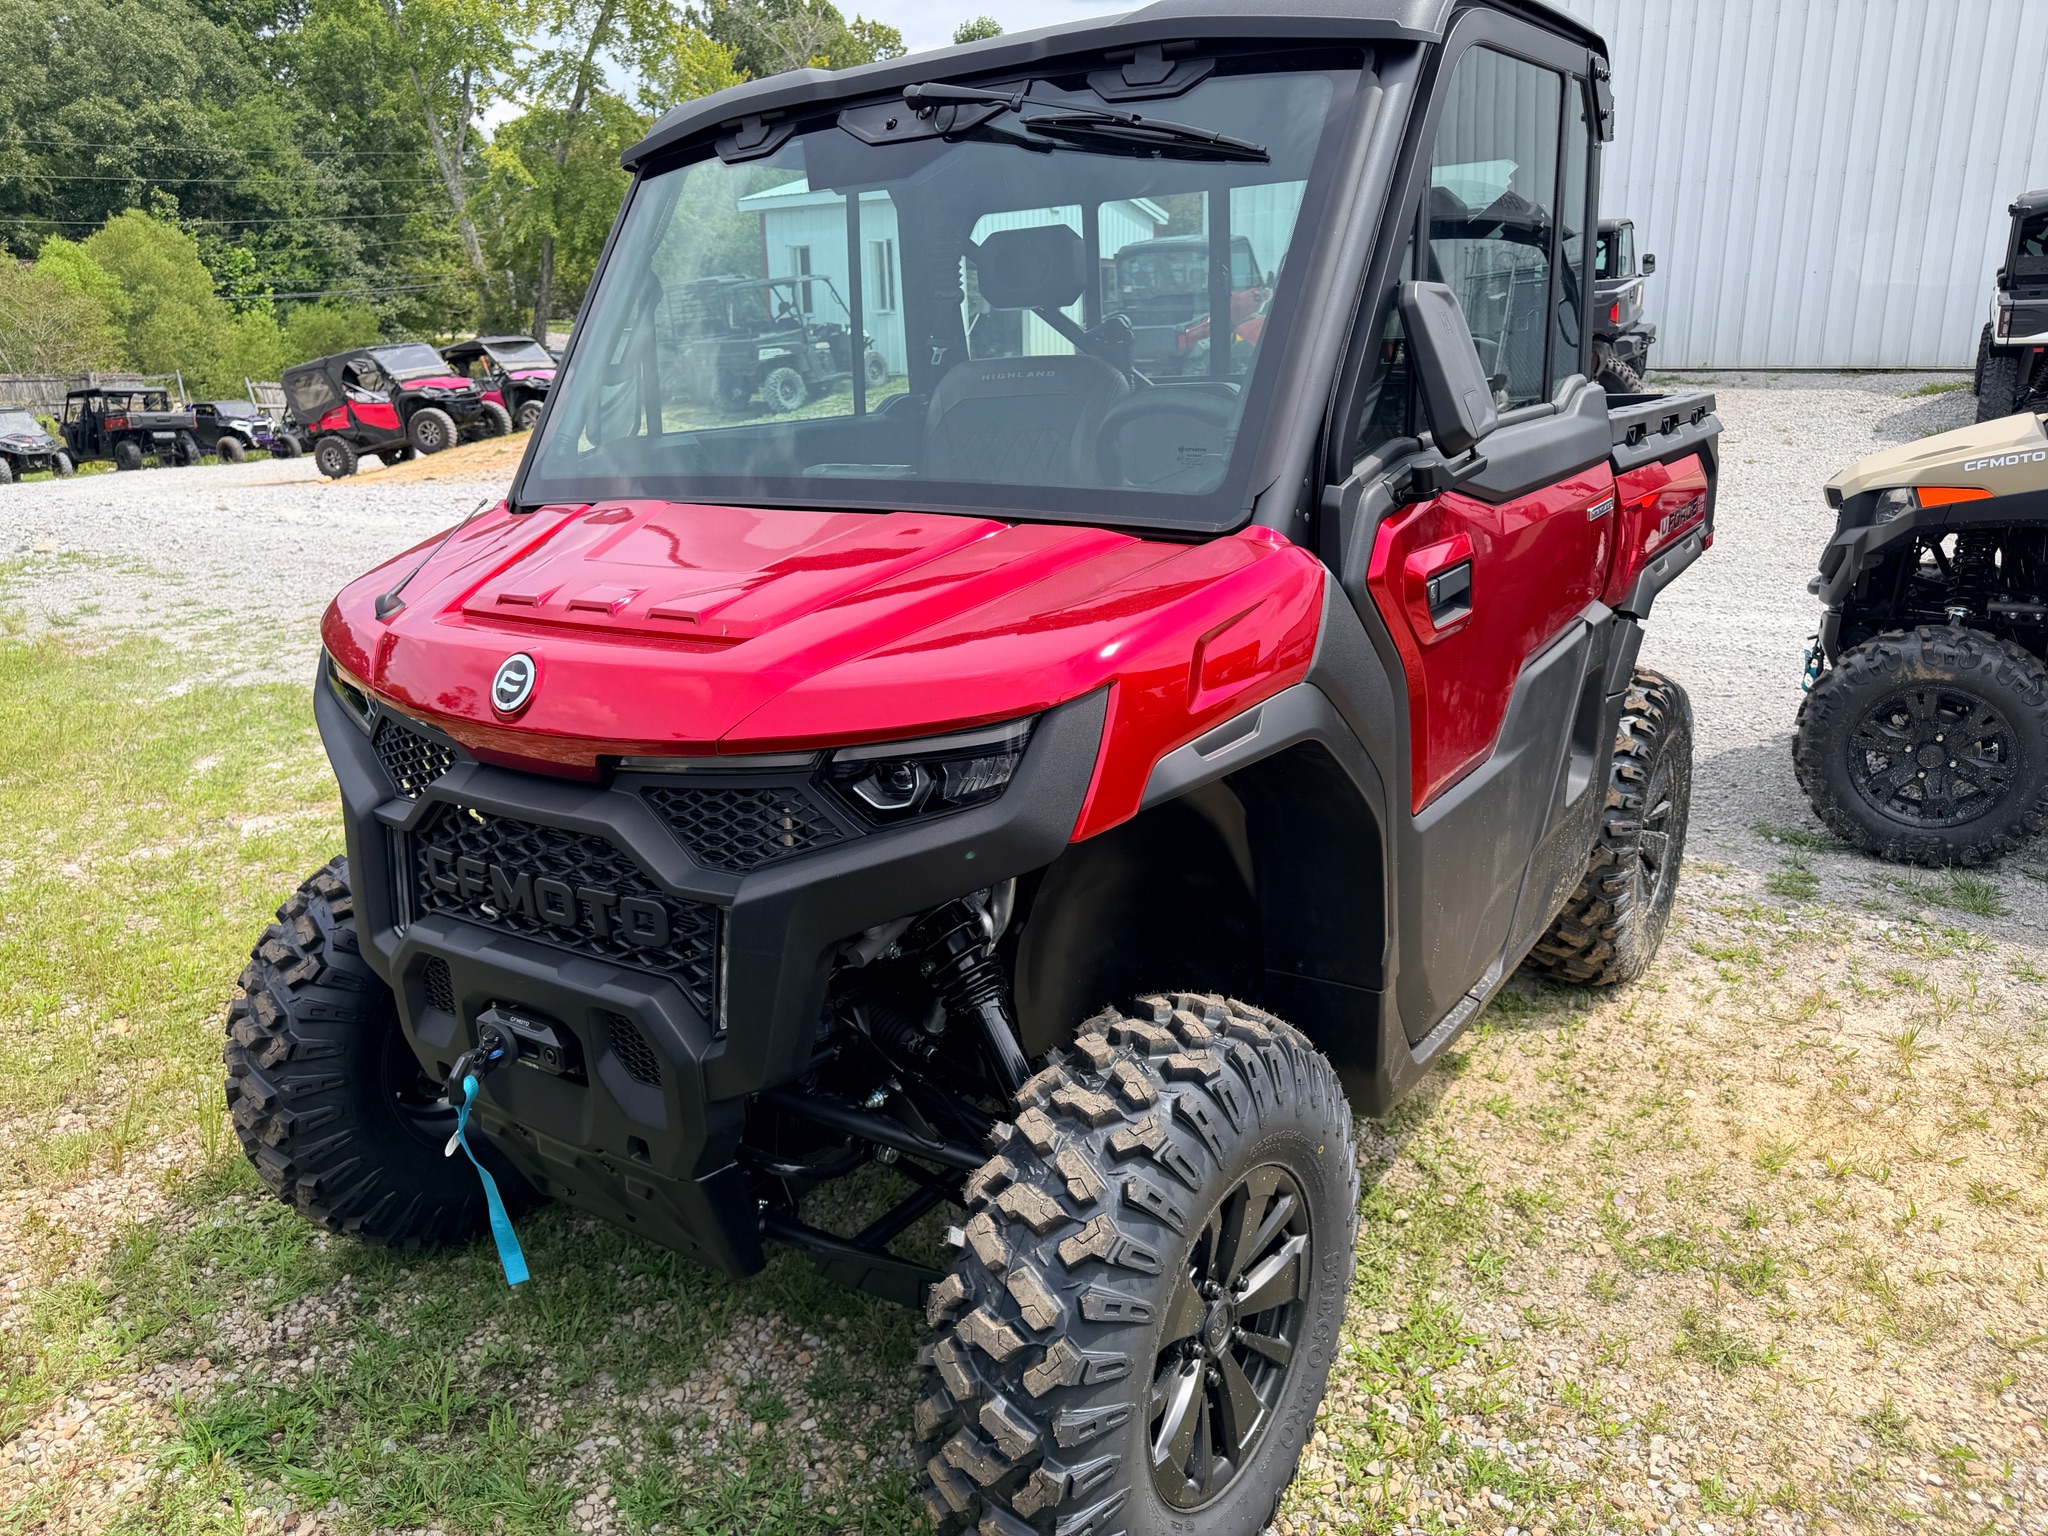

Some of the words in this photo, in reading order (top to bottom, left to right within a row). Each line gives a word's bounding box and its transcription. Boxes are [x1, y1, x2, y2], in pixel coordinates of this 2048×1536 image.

[981, 370, 1056, 381] HIGHLAND
[1963, 451, 2046, 472] CFMOTO
[427, 846, 670, 947] CFMOTO
[509, 1015, 530, 1027] CFMOTO
[1306, 1250, 1341, 1369] STEGO
